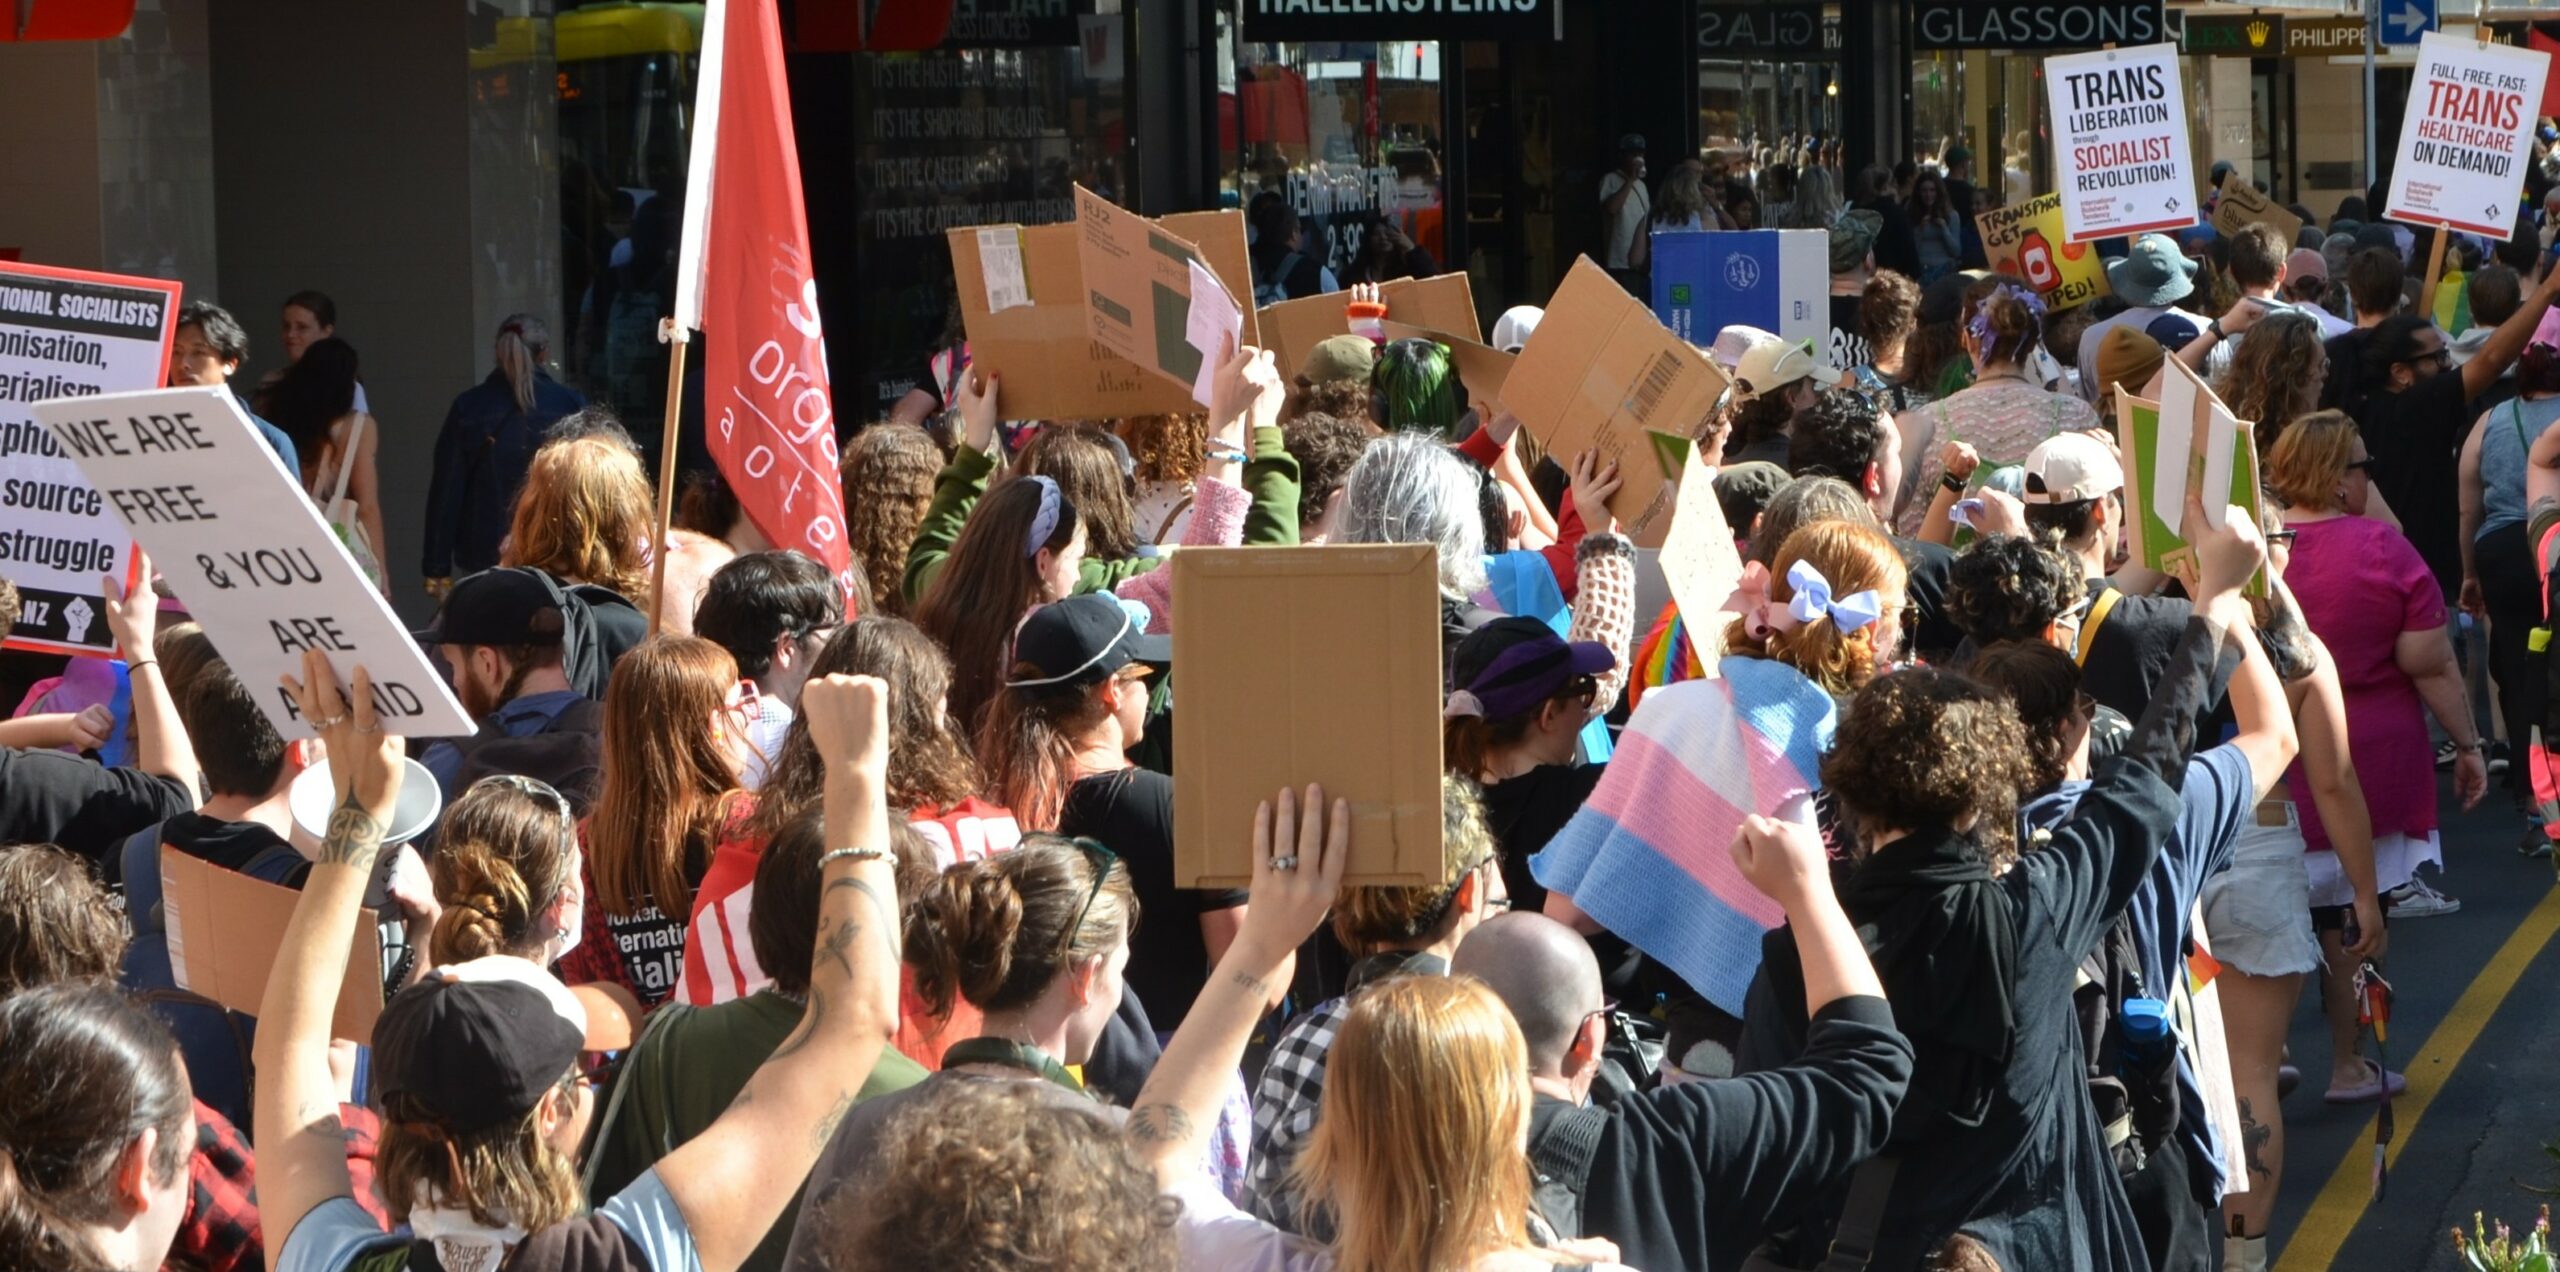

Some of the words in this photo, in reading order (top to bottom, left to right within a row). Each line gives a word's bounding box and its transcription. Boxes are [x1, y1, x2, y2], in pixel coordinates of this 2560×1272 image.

[1922, 5, 2154, 43] GLASSONS
[2065, 64, 2165, 110] TRANS
[2430, 63, 2460, 82] FULL,
[2462, 68, 2495, 88] FREE,
[2497, 74, 2527, 92] FAST:
[2069, 103, 2169, 133] LIBERATION
[2427, 80, 2523, 131] TRANS
[2074, 136, 2171, 171] SOCIALIST
[2418, 120, 2515, 153] HEALTHCARE
[2077, 163, 2177, 193] REVOLUTION!
[2413, 141, 2436, 164] ON
[2438, 145, 2511, 178] DEMAND!
[1084, 200, 1111, 225] RJ2
[1988, 224, 2020, 247] GET
[58, 294, 160, 328] SOCIALISTS
[53, 419, 131, 458] WE
[128, 412, 215, 454] ARE
[3, 478, 102, 516] source
[108, 485, 219, 526] FREE
[0, 529, 115, 573] struggle
[268, 617, 356, 655] ARE
